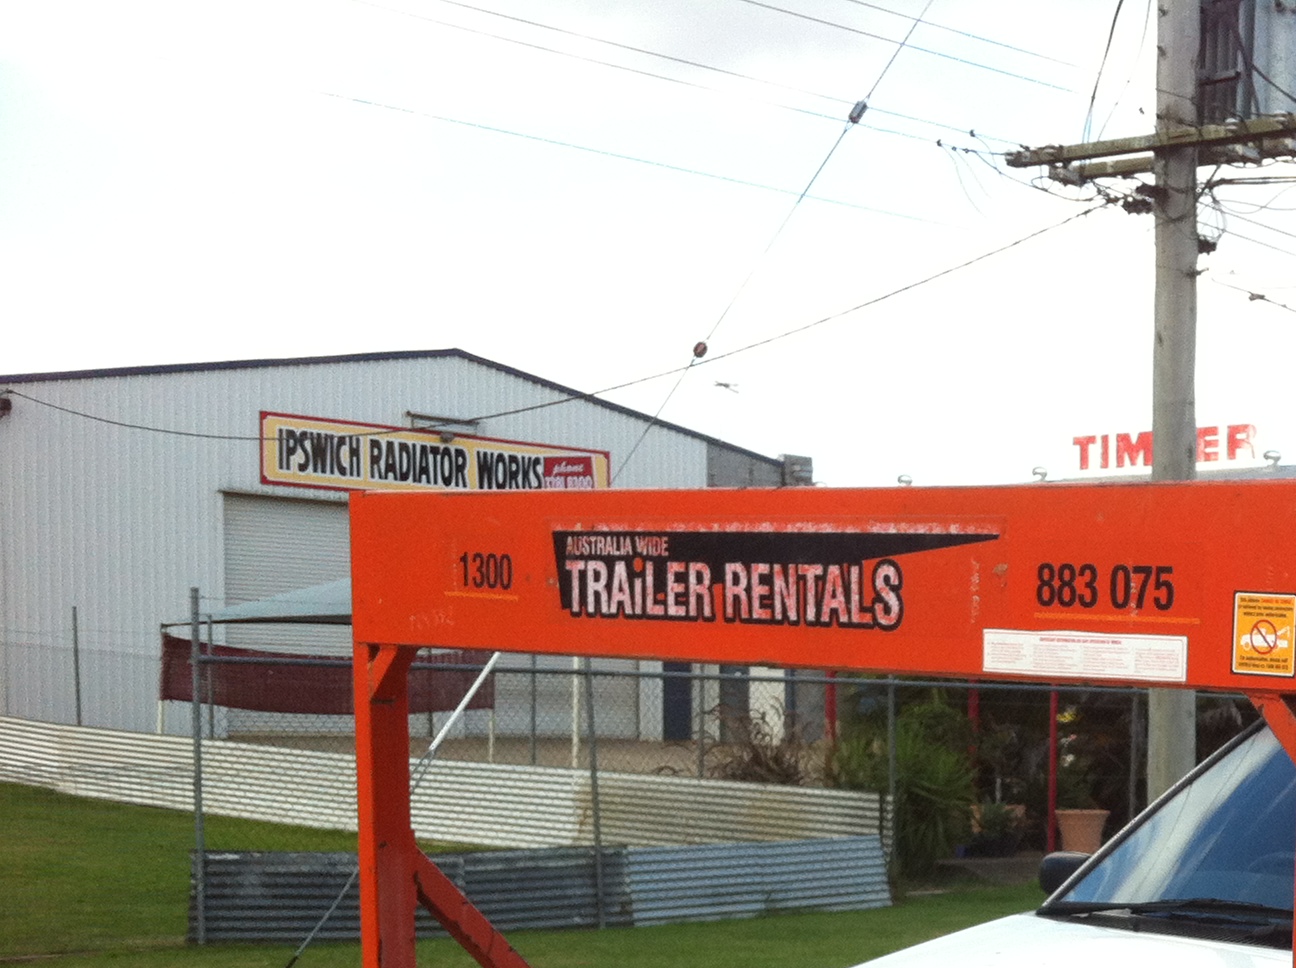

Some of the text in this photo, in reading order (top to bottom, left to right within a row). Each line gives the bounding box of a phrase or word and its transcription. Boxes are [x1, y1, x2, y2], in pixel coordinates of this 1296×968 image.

[278, 428, 542, 489] IPSWICH RADIATOR WORKS
[1073, 424, 1257, 469] TIMER
[566, 536, 669, 556] AUSTRALIA WIDE
[458, 553, 513, 591] 1300
[722, 561, 903, 629] RENTALS
[1036, 563, 1174, 611] 883 075
